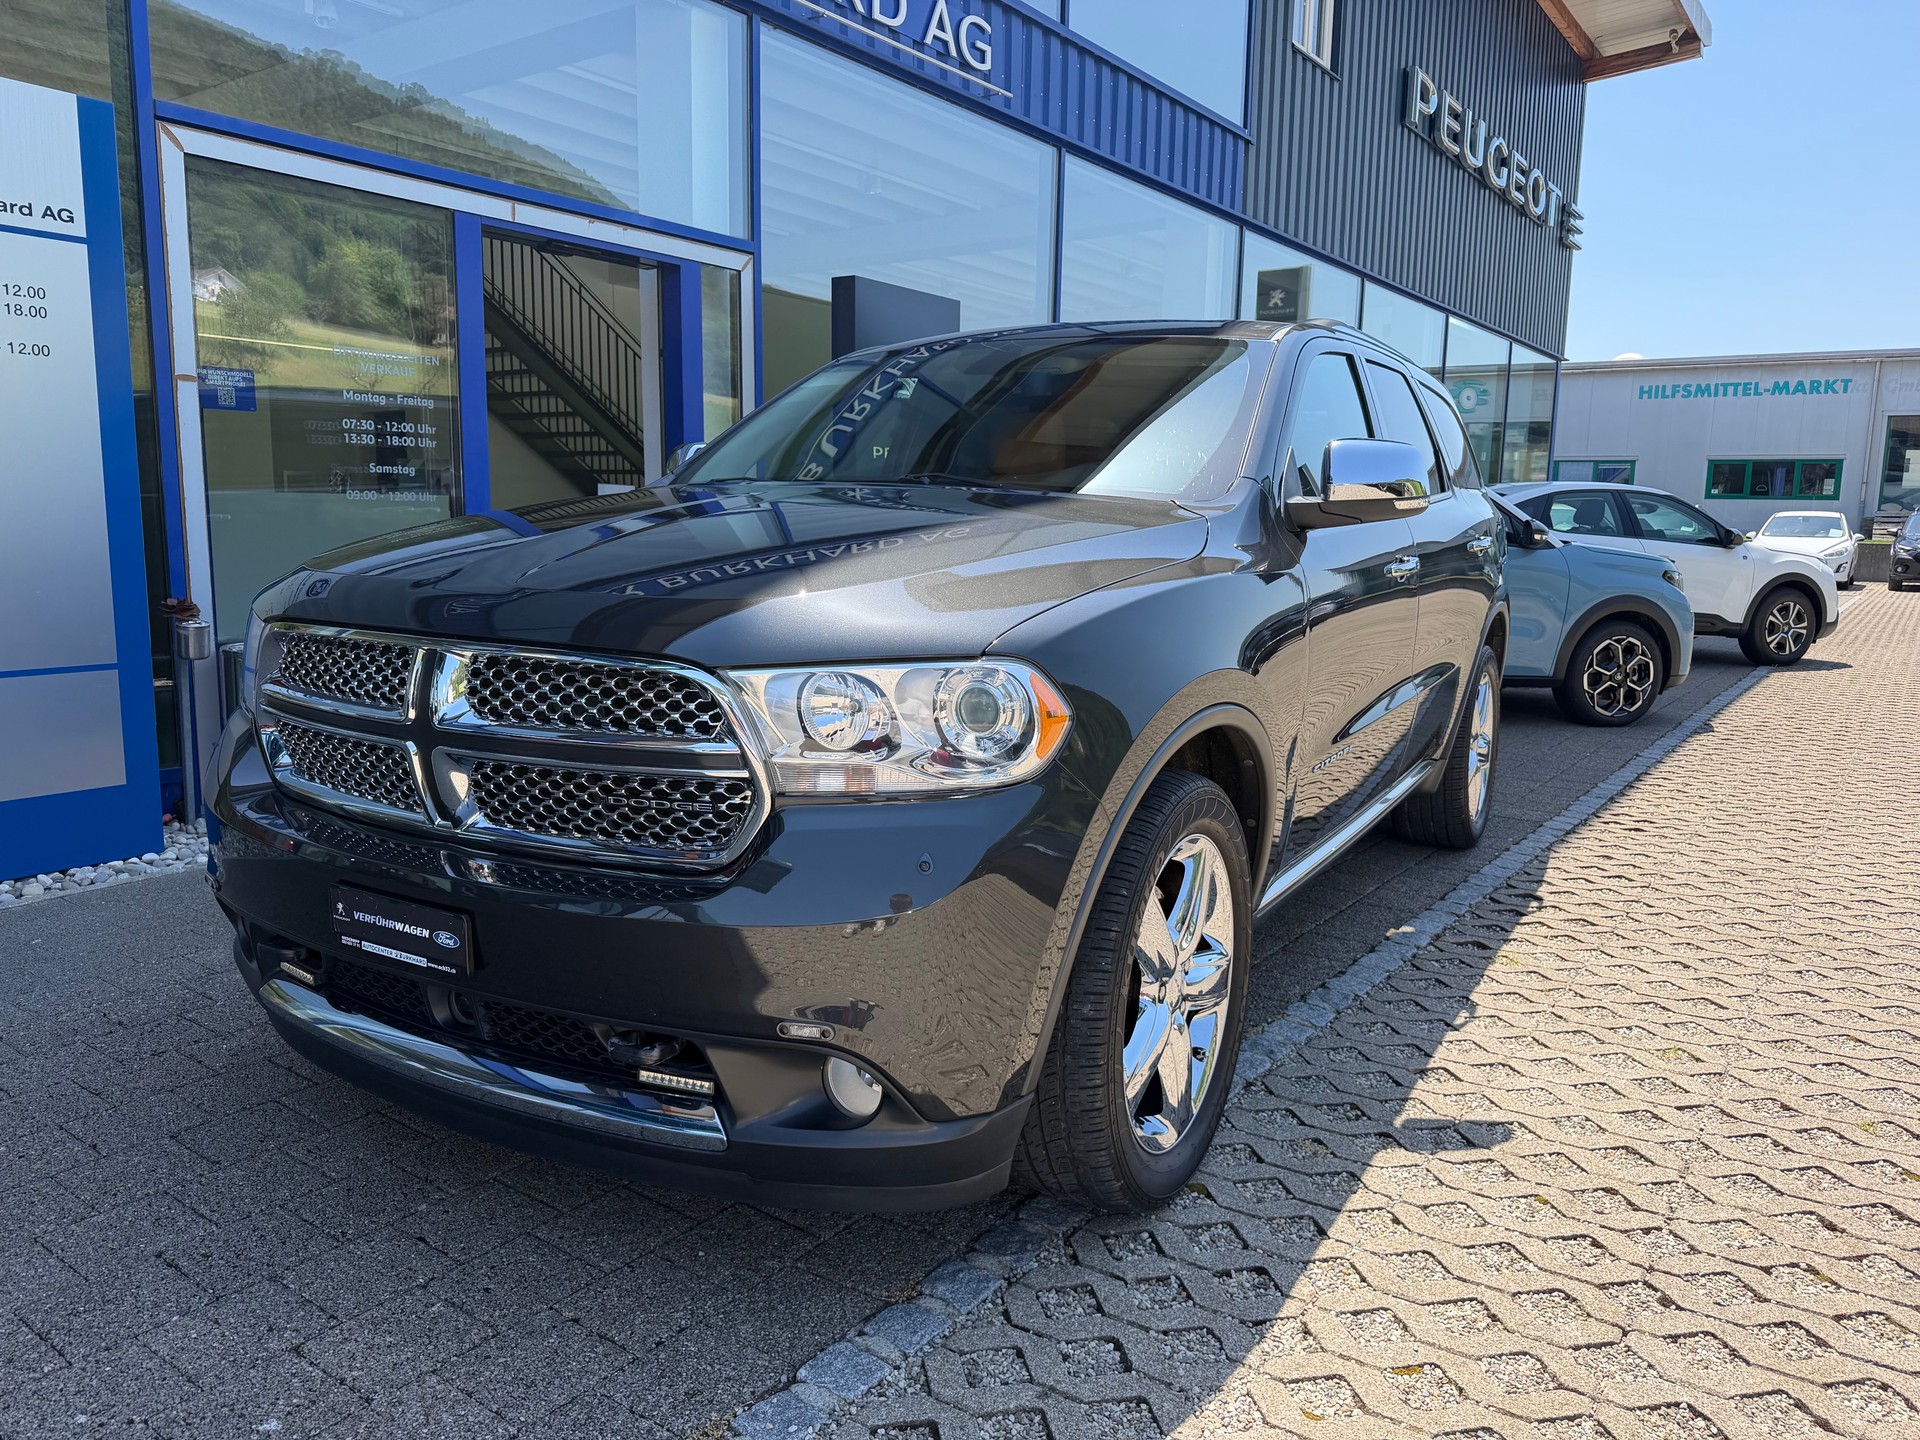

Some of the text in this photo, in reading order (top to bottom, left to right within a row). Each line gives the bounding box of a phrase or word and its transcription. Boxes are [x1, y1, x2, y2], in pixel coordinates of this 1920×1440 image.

[923, 0, 992, 71] AG
[1407, 65, 1562, 227] PEUGEOT
[41, 205, 75, 224] AG
[2, 283, 46, 300] 12.00
[4, 302, 47, 319] 18.00
[7, 341, 50, 357] 12.00
[333, 343, 440, 366] ÖFFNUNGSZEITEN
[207, 369, 253, 378] WUNSCHMODELL
[360, 363, 416, 377] VERKAUF
[1638, 379, 1852, 400] HILFSMITTEL-MARKT
[343, 389, 386, 405] Montag
[397, 394, 434, 409] Freitag
[342, 418, 374, 431] 07:30
[385, 421, 414, 433] 12:00
[417, 423, 437, 435] Uhr
[343, 433, 375, 445] 13:30
[386, 435, 415, 447] 18:00
[418, 437, 437, 448] Uhr
[369, 462, 416, 477] Samstag
[346, 489, 377, 501] 09:00
[388, 491, 416, 501] 12:00
[418, 492, 437, 502] Uhr
[607, 796, 713, 812] DODGE
[353, 910, 430, 939] VERFÜHRWAGEN
[436, 932, 457, 947] Ford
[362, 943, 427, 965] AUTOCENTER BURKHARD
